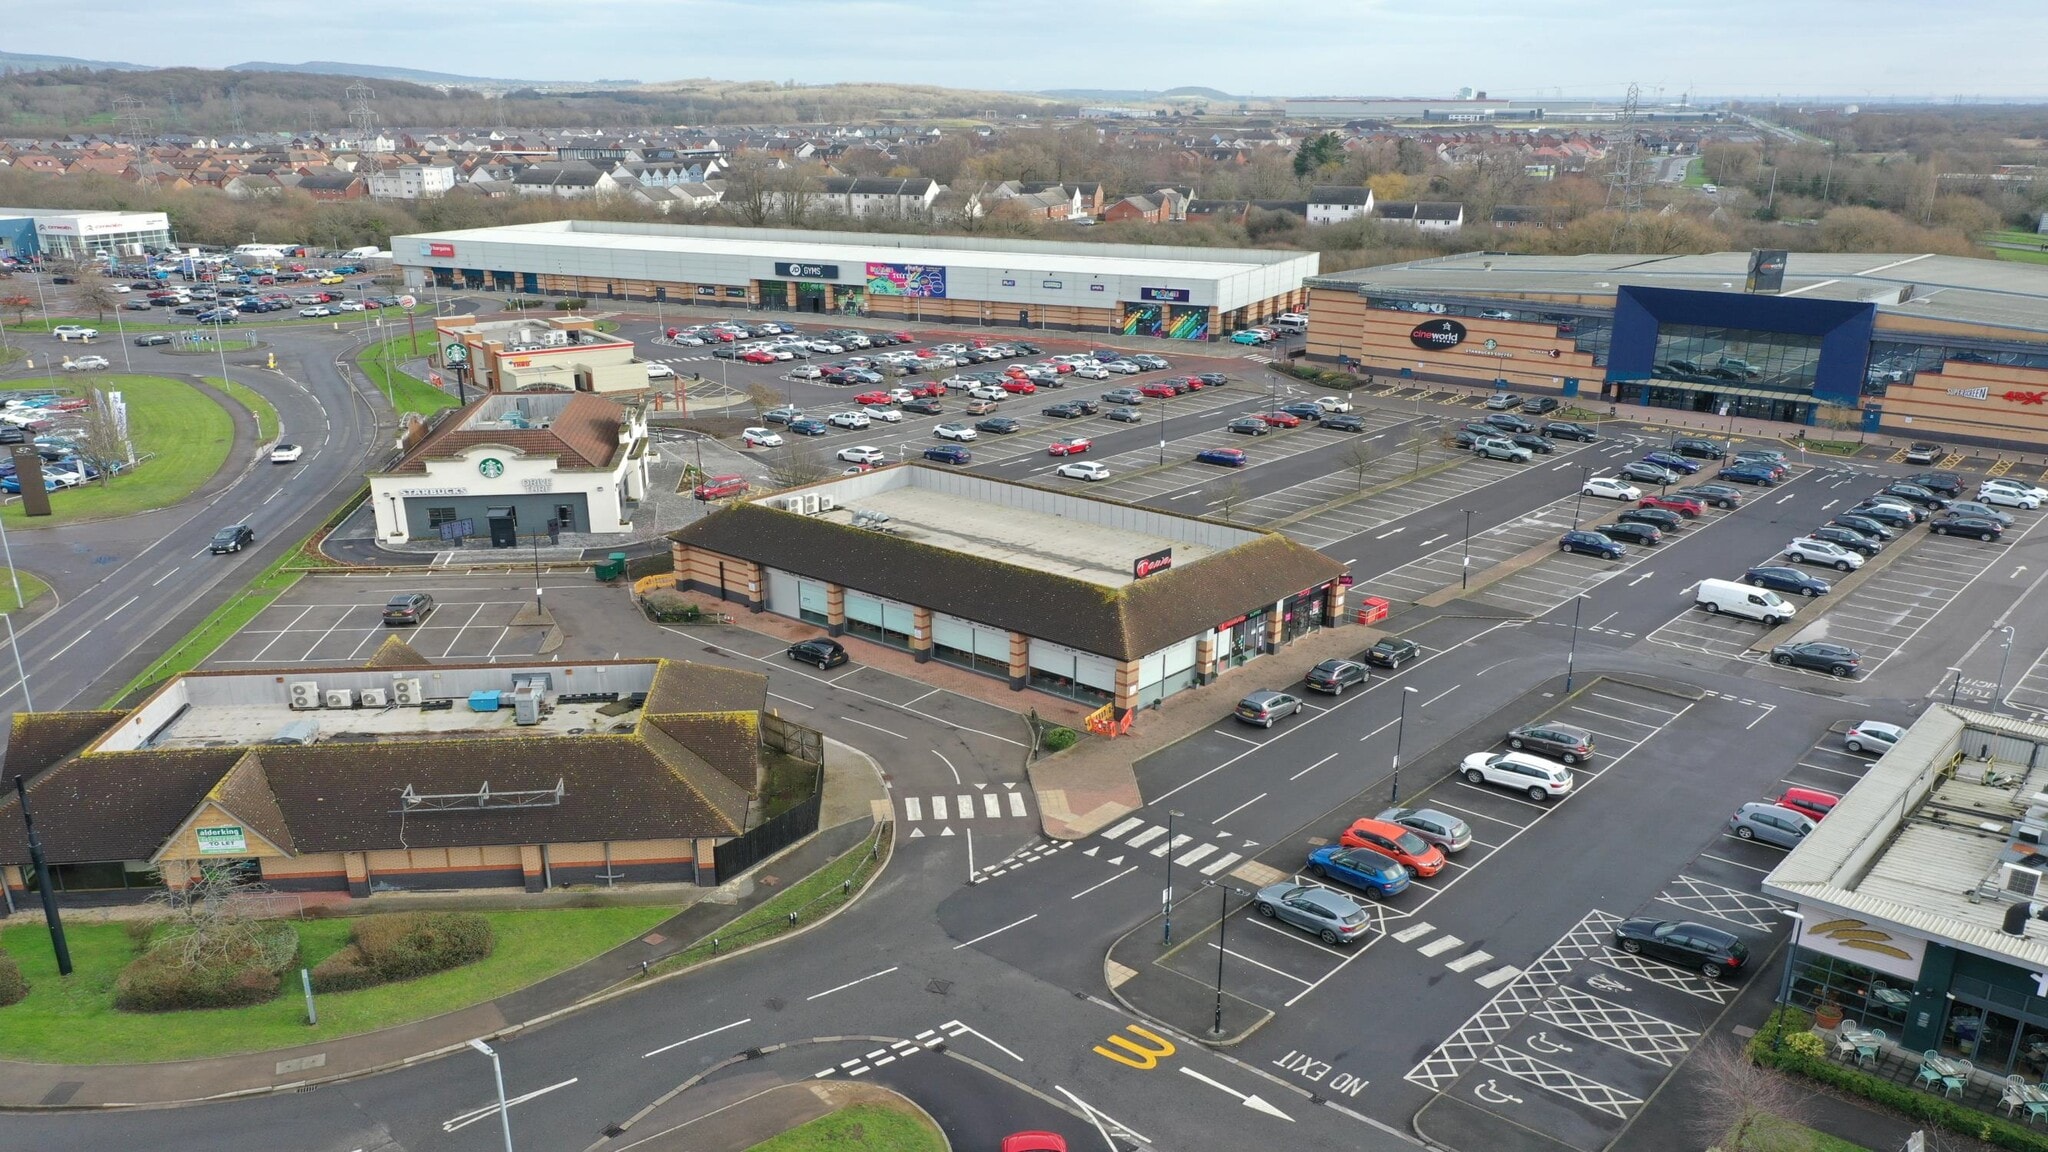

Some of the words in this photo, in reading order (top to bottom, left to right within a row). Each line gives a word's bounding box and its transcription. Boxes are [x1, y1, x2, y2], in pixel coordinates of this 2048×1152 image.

[803, 267, 822, 276] GYMS
[1412, 330, 1458, 341] cineworld
[520, 478, 553, 487] DRIVE
[399, 487, 468, 496] STARBUCKS
[1272, 1050, 1333, 1082] EXIT
[1329, 1072, 1370, 1098] NO
